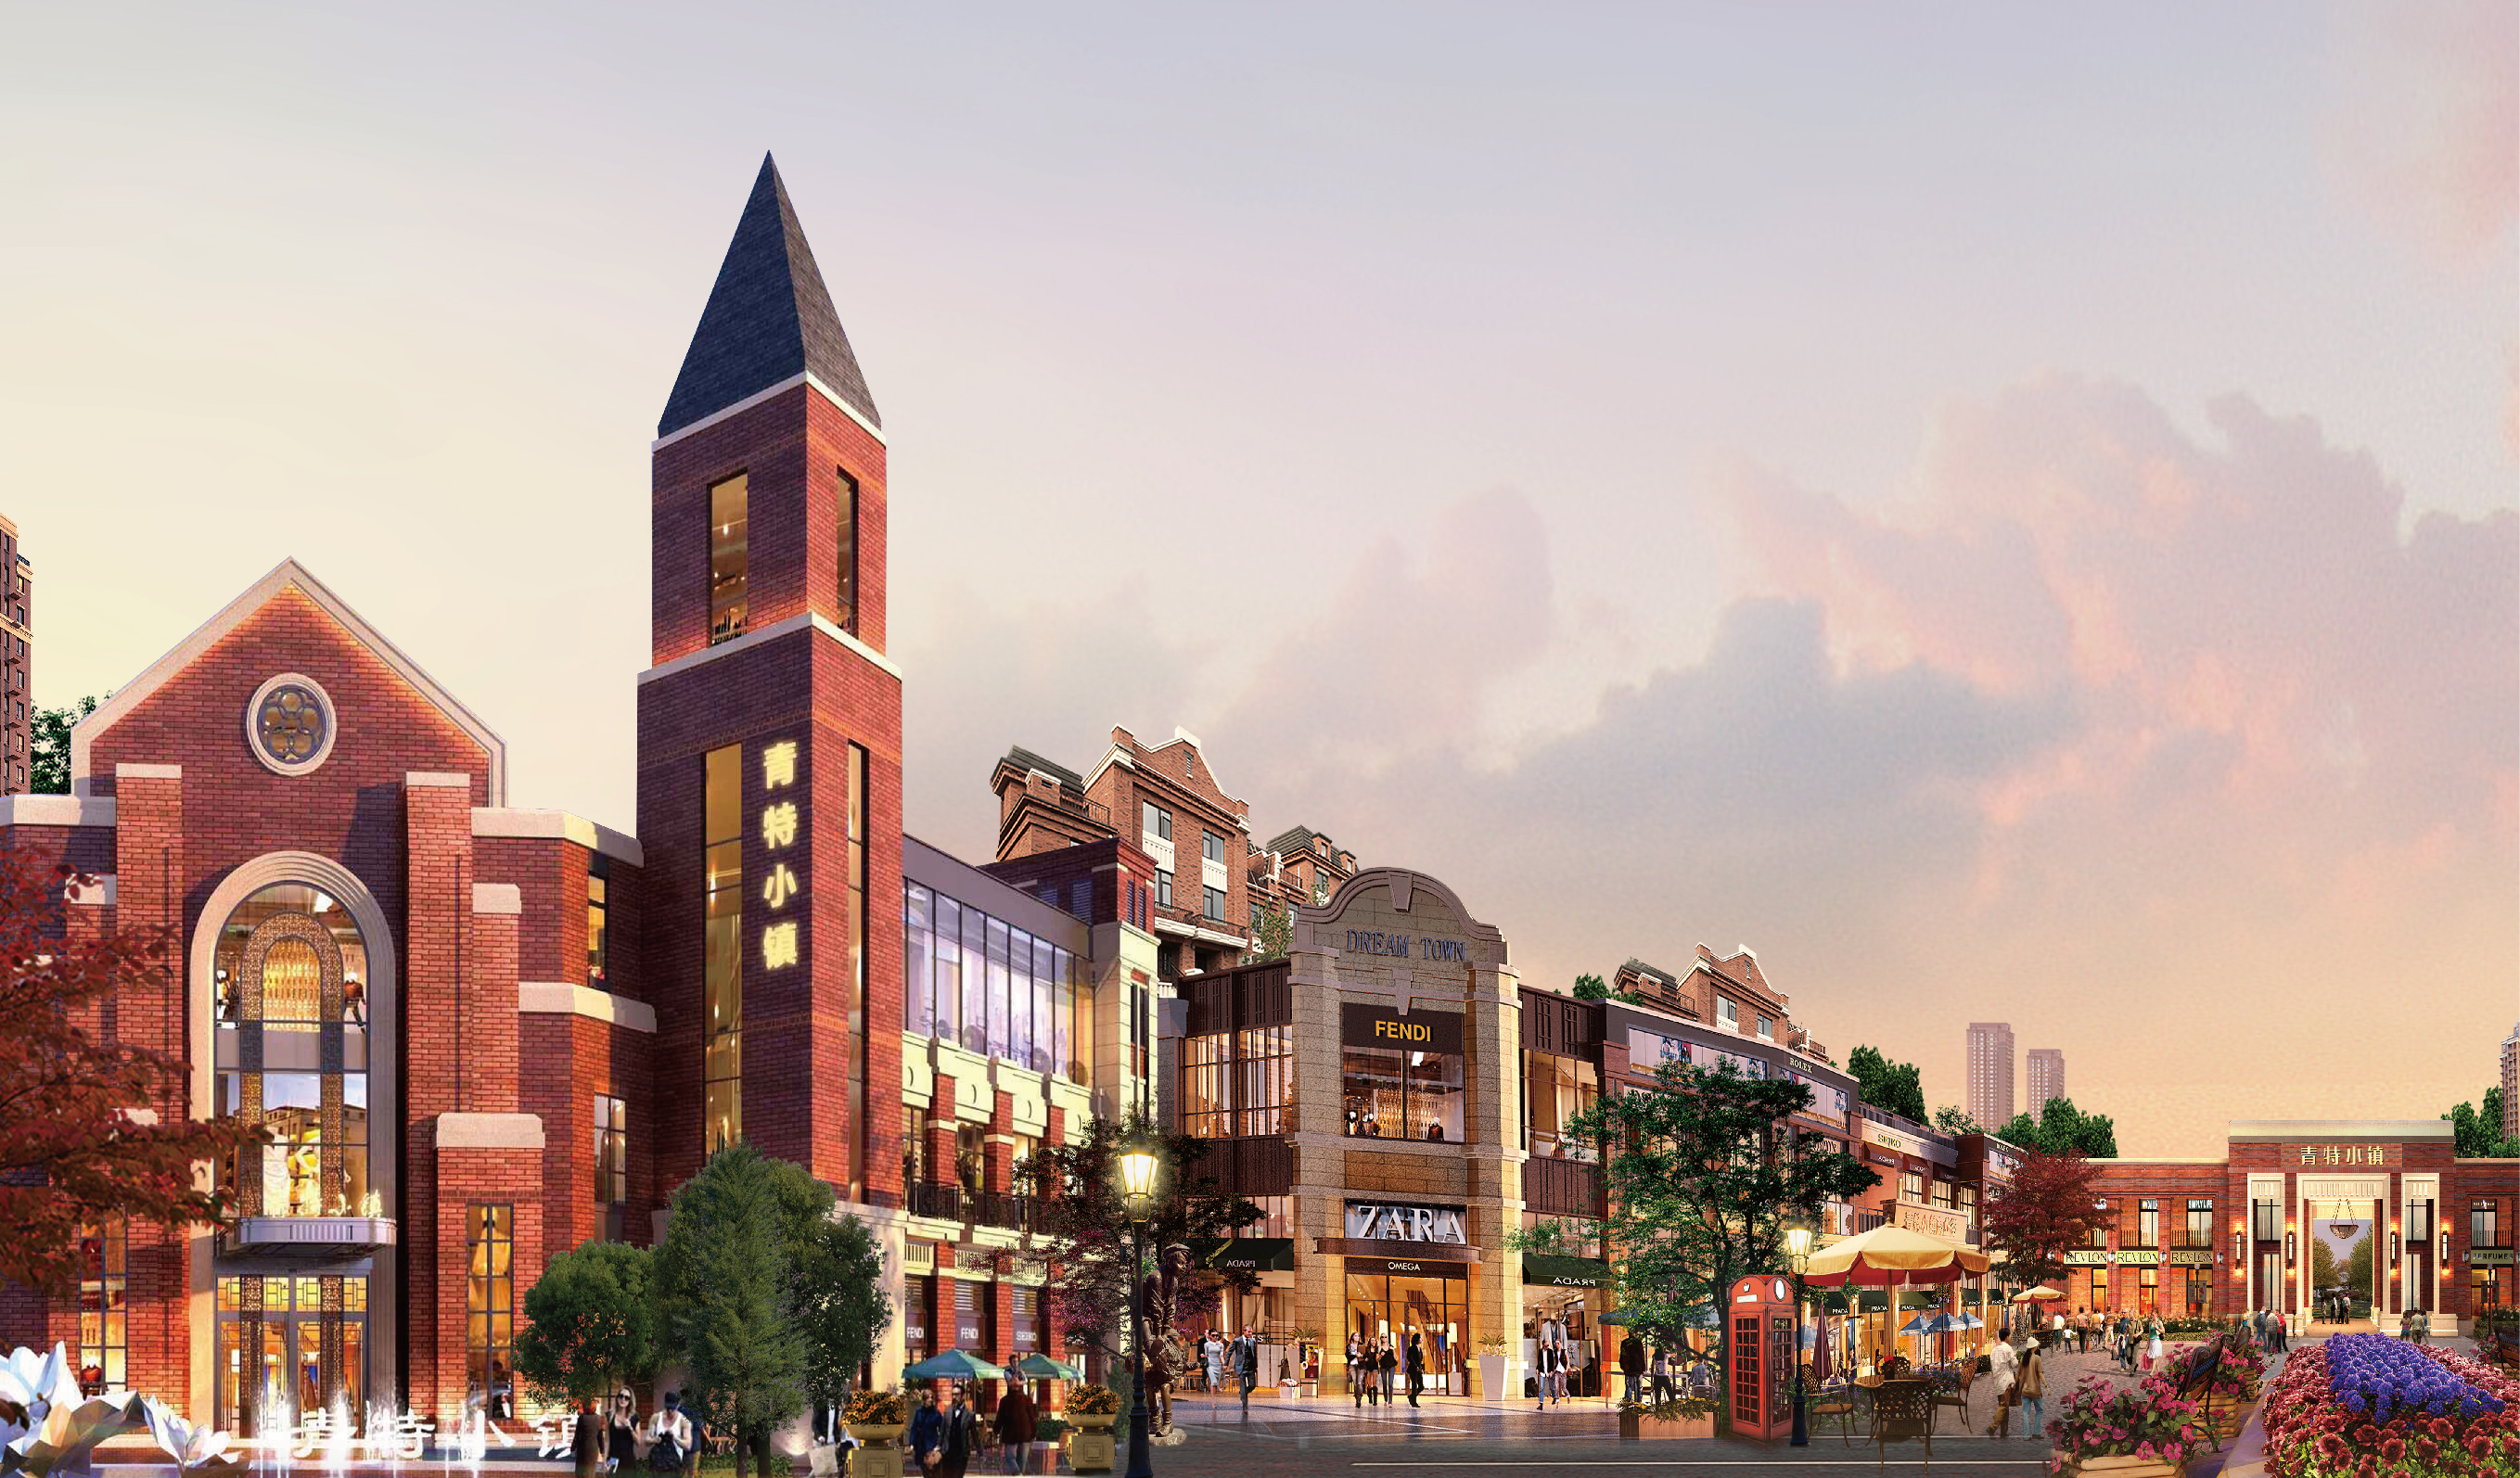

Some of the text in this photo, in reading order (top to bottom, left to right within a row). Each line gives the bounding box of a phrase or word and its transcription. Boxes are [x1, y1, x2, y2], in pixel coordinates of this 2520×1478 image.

[762, 741, 798, 971] 青特小镇
[1347, 929, 1466, 962] DREAM TOWN
[1375, 1020, 1431, 1042] FENDI
[1789, 1057, 1812, 1074] ROLEX
[1877, 1133, 1901, 1149] SEIKO
[2300, 1145, 2384, 1166] 青特小镇
[1357, 1205, 1467, 1245] ZARA
[2066, 1252, 2107, 1263] REVLON
[2117, 1252, 2158, 1263] REVLON
[2171, 1252, 2213, 1263] REVLON
[1388, 1261, 1421, 1271] OMEGA
[906, 1327, 925, 1339] FENDI
[961, 1327, 979, 1339] FENDI
